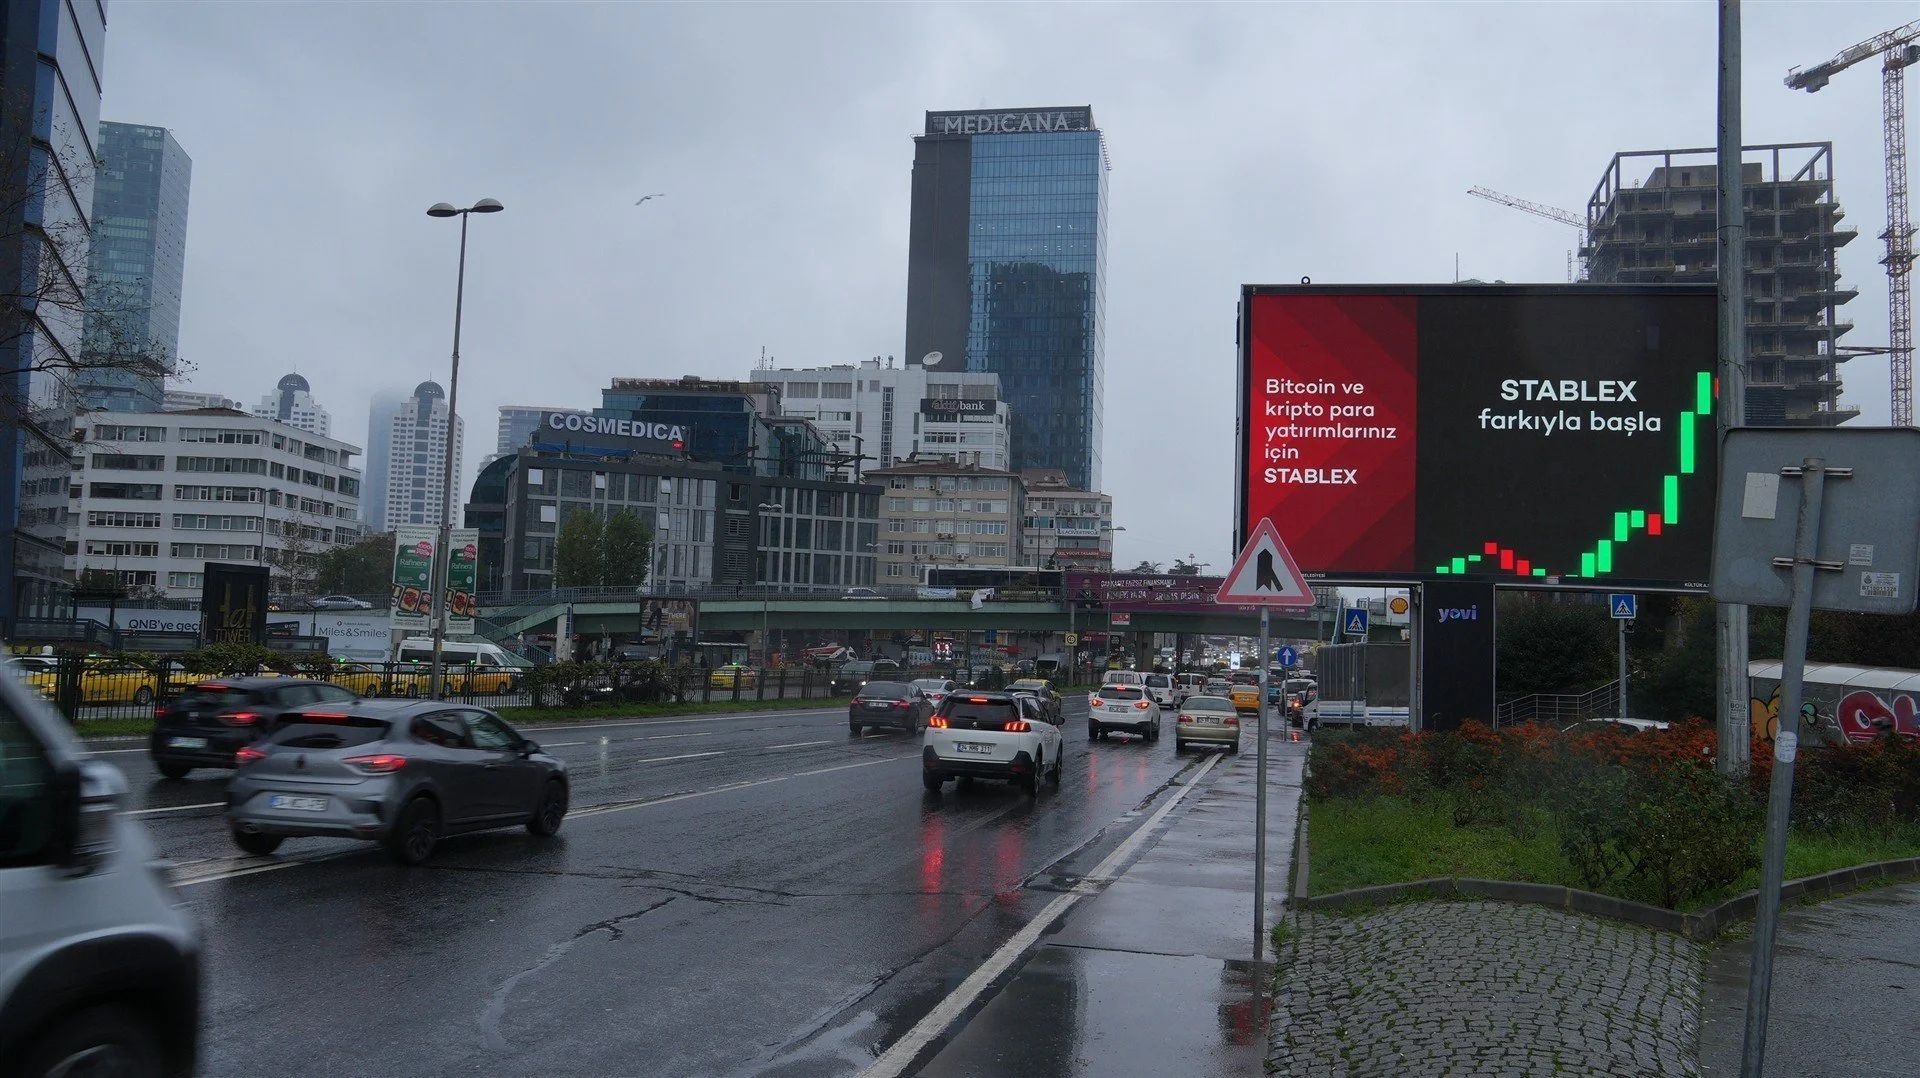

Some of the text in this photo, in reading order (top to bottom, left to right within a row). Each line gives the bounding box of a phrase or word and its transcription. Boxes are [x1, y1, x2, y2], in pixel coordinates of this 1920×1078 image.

[944, 112, 1069, 134] MEDICANA
[1265, 377, 1365, 394] Bitcoin ve
[1500, 379, 1638, 402] STABLEX
[959, 400, 986, 411] bank
[1265, 400, 1375, 421] kripto para
[548, 412, 684, 442] COSMEDICA
[1478, 407, 1661, 437] farkıyla başla
[1264, 422, 1397, 442] yatırımlarınız
[1264, 443, 1299, 463] için
[1264, 467, 1358, 484] STABLEX
[1438, 604, 1477, 623] yovi
[128, 619, 174, 632] QNB'ye
[214, 628, 251, 642] TOWER
[318, 626, 388, 638] Miles&Smiles
